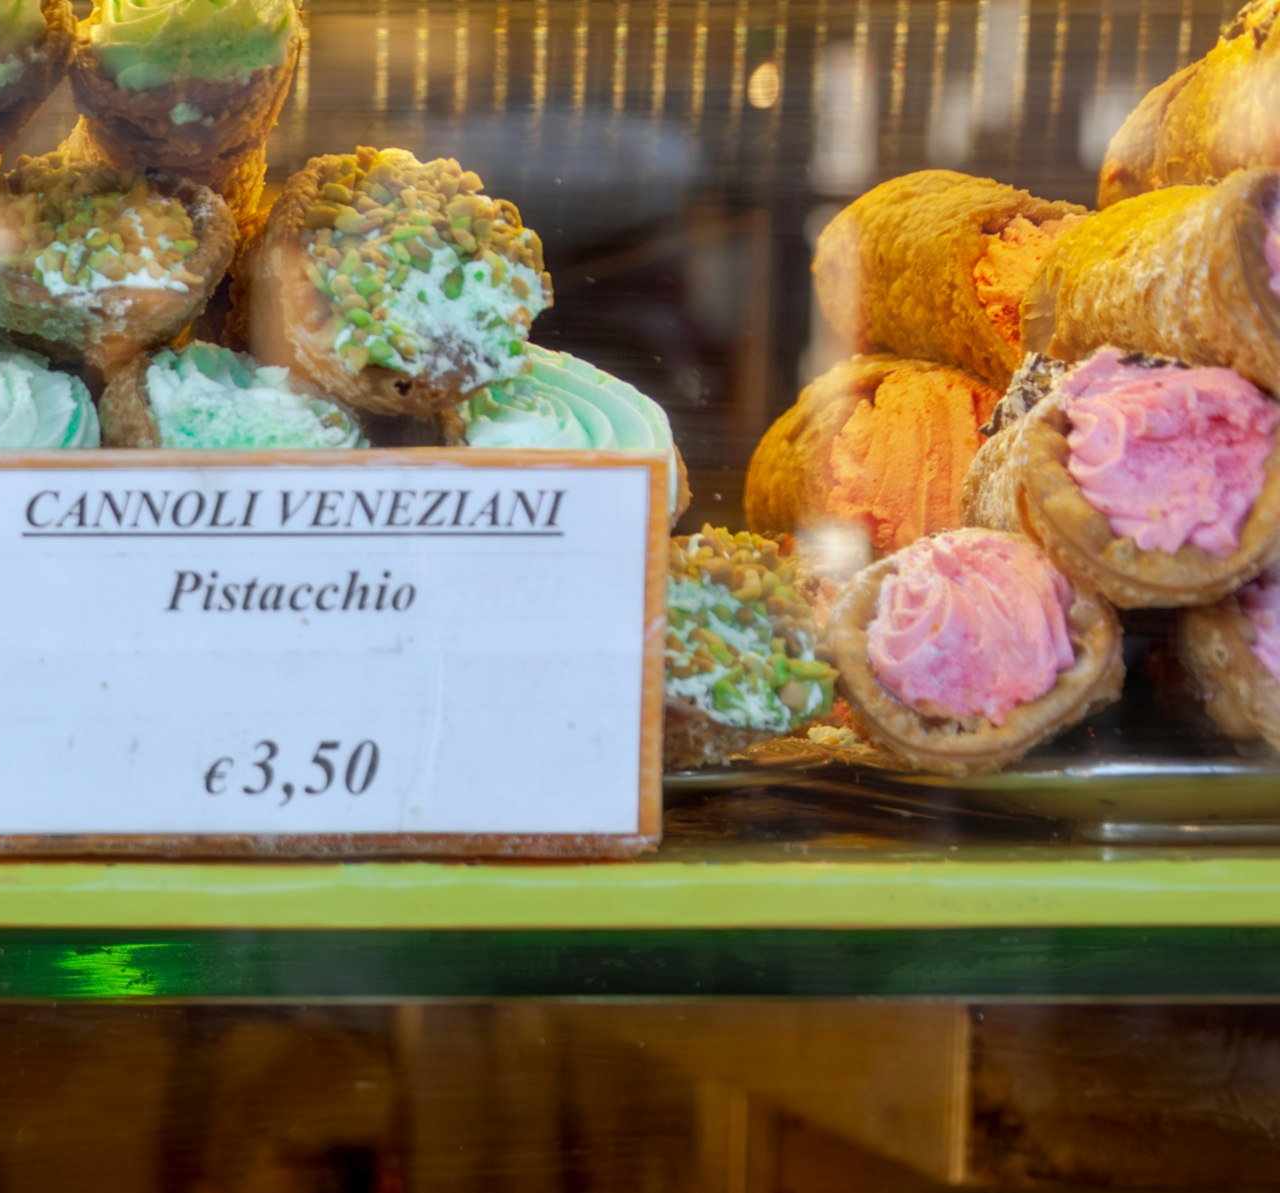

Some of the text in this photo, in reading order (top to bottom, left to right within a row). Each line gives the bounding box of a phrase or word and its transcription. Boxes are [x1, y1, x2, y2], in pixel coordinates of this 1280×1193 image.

[23, 489, 567, 529] CANNOLI VENEZIANI
[164, 570, 417, 613] Pistacchio
